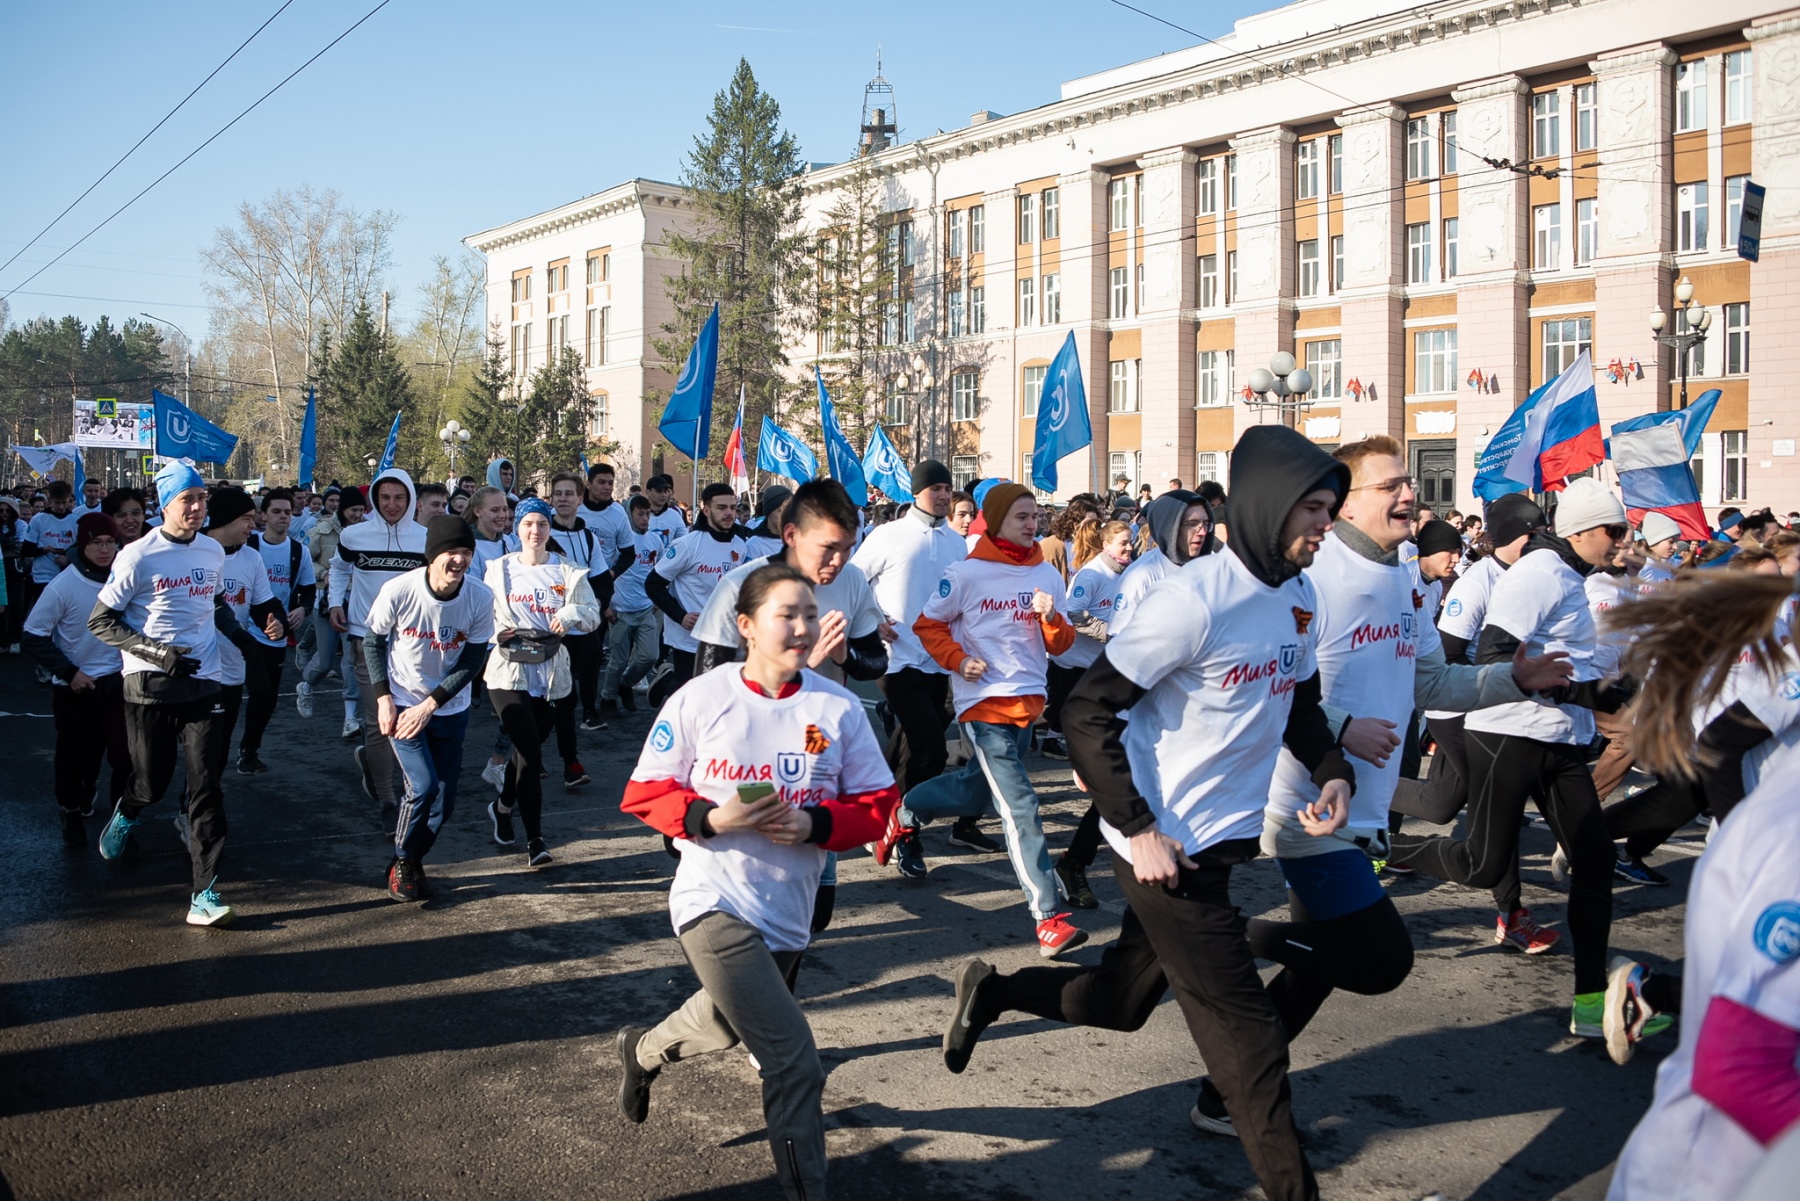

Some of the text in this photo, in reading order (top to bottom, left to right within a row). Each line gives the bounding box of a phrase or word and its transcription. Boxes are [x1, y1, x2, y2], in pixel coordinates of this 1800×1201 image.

[368, 557, 422, 568] DEMIX
[697, 564, 722, 575] Миля
[156, 575, 192, 592] Миля
[188, 584, 214, 599] Мира
[530, 603, 556, 617] Мира
[980, 598, 1017, 614] Миля
[402, 627, 436, 640] Миля
[1351, 624, 1399, 649] Миля
[428, 641, 460, 653] Мира
[1222, 659, 1277, 688] Миля
[703, 758, 773, 782] Миля
